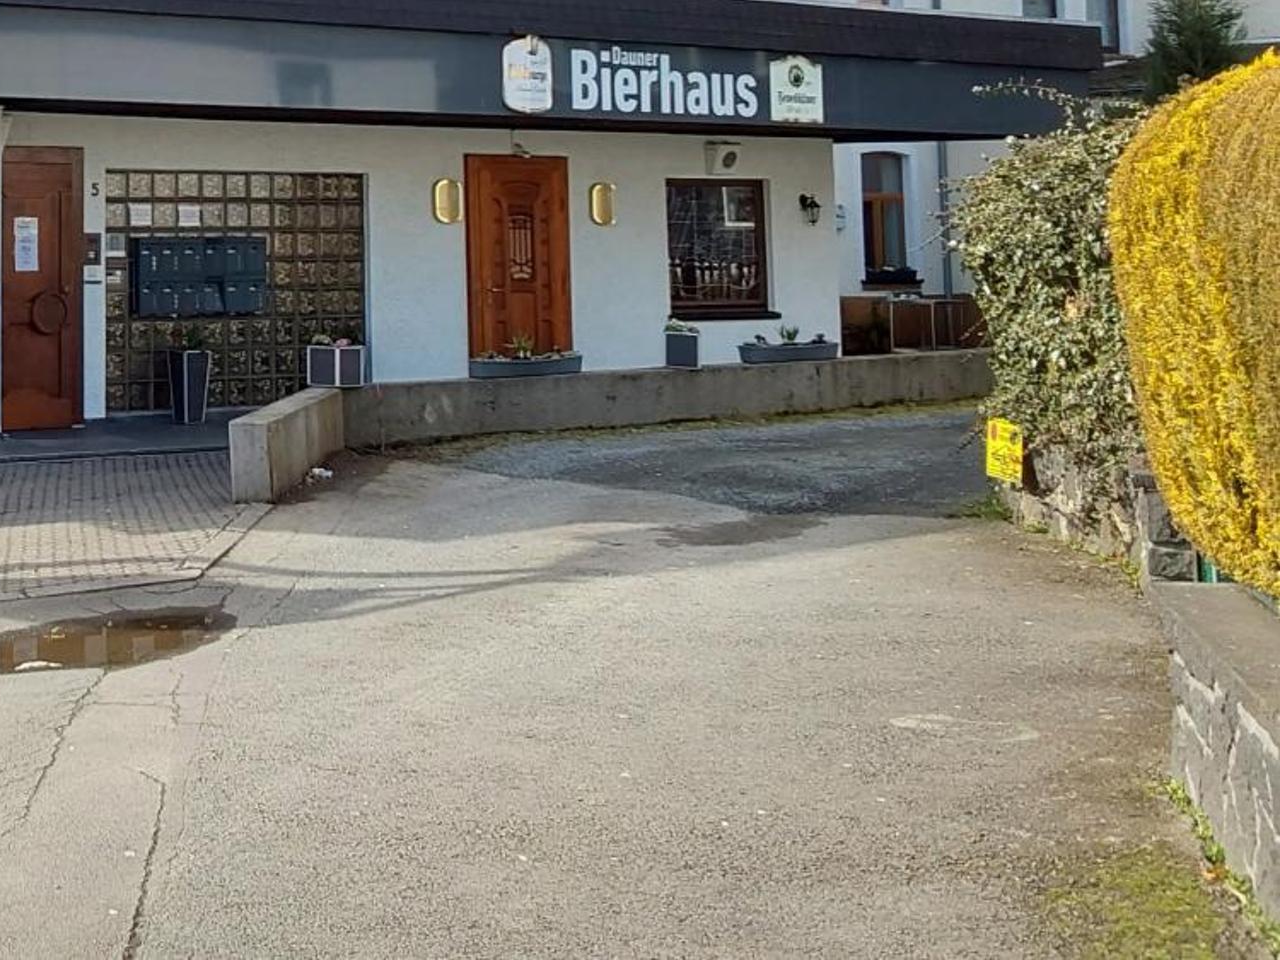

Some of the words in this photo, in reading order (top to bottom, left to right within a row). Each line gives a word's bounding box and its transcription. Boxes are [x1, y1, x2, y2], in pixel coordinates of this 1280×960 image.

[611, 46, 660, 67] Dauner
[571, 48, 758, 118] Bierhaus
[91, 183, 100, 196] 5
